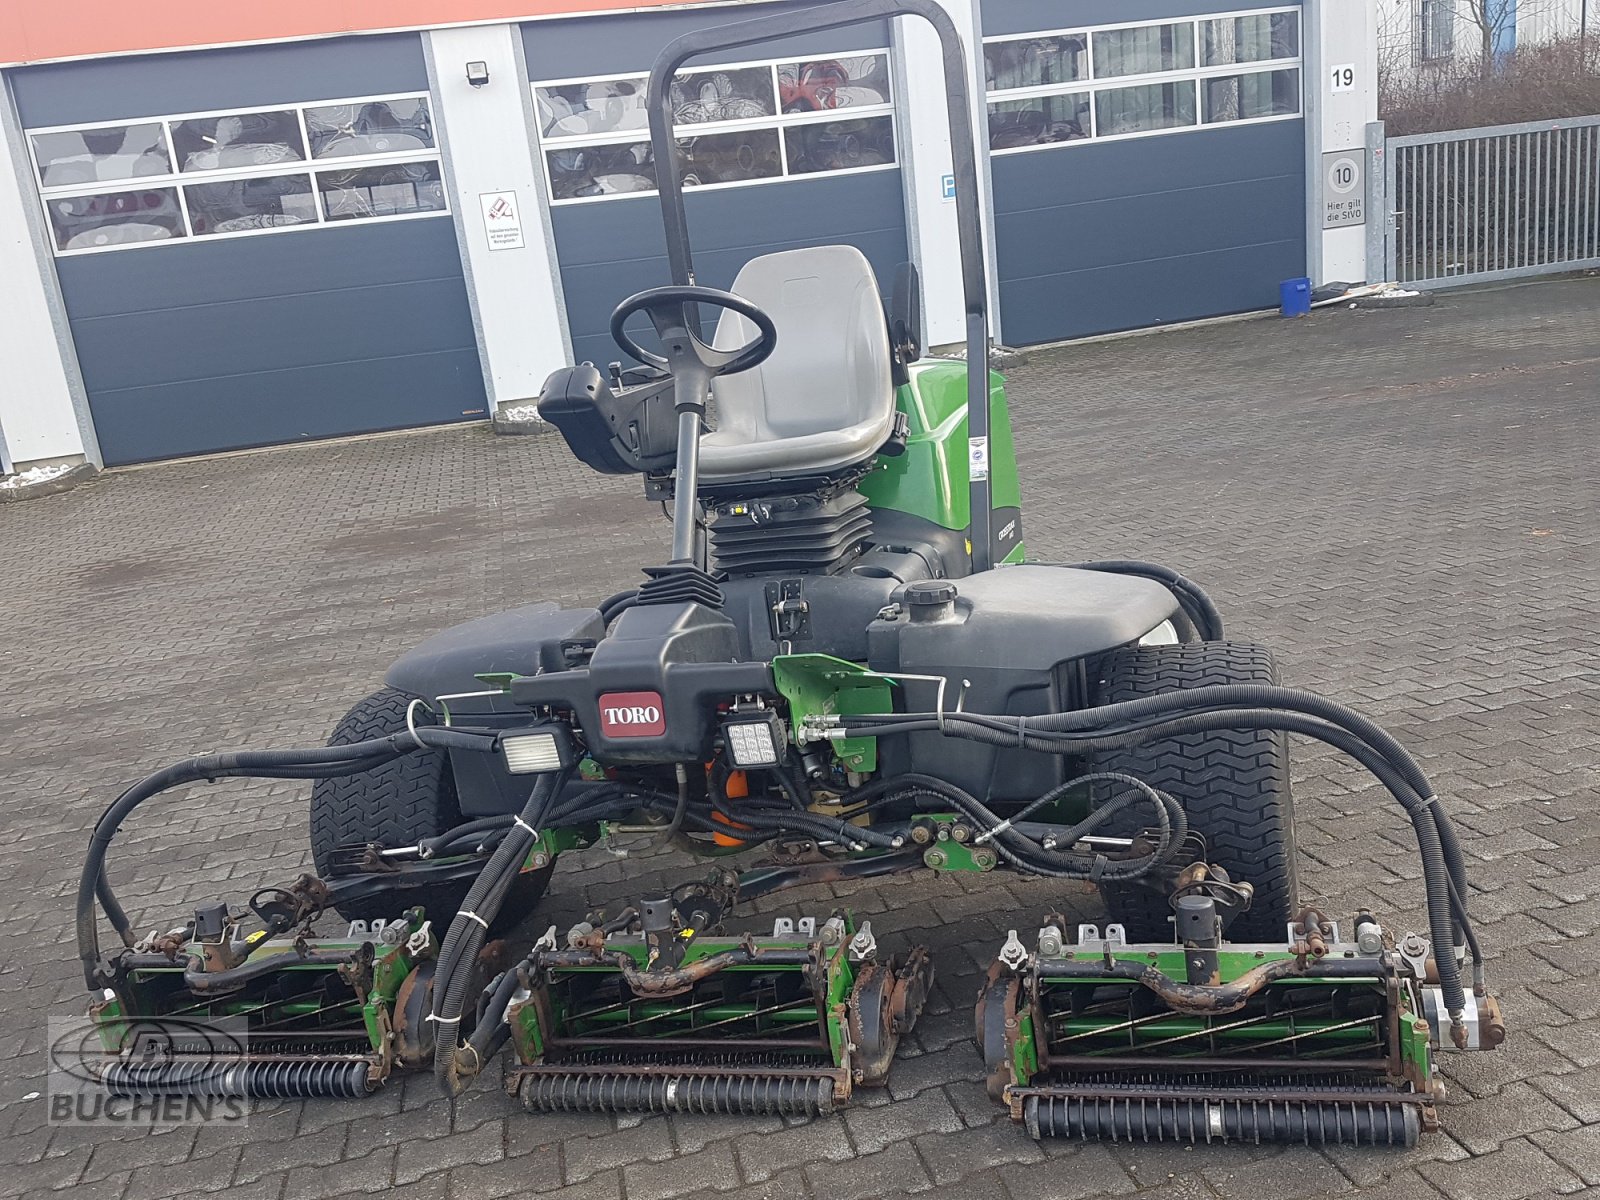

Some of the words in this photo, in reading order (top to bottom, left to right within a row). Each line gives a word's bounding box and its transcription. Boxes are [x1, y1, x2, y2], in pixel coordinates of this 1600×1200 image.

[1332, 68, 1353, 87] 19
[1335, 167, 1351, 184] 10
[1327, 202, 1344, 211] Hier
[1348, 198, 1361, 209] gilt
[1327, 213, 1340, 221] die
[1342, 209, 1362, 220] StVO
[604, 706, 660, 725] TORO
